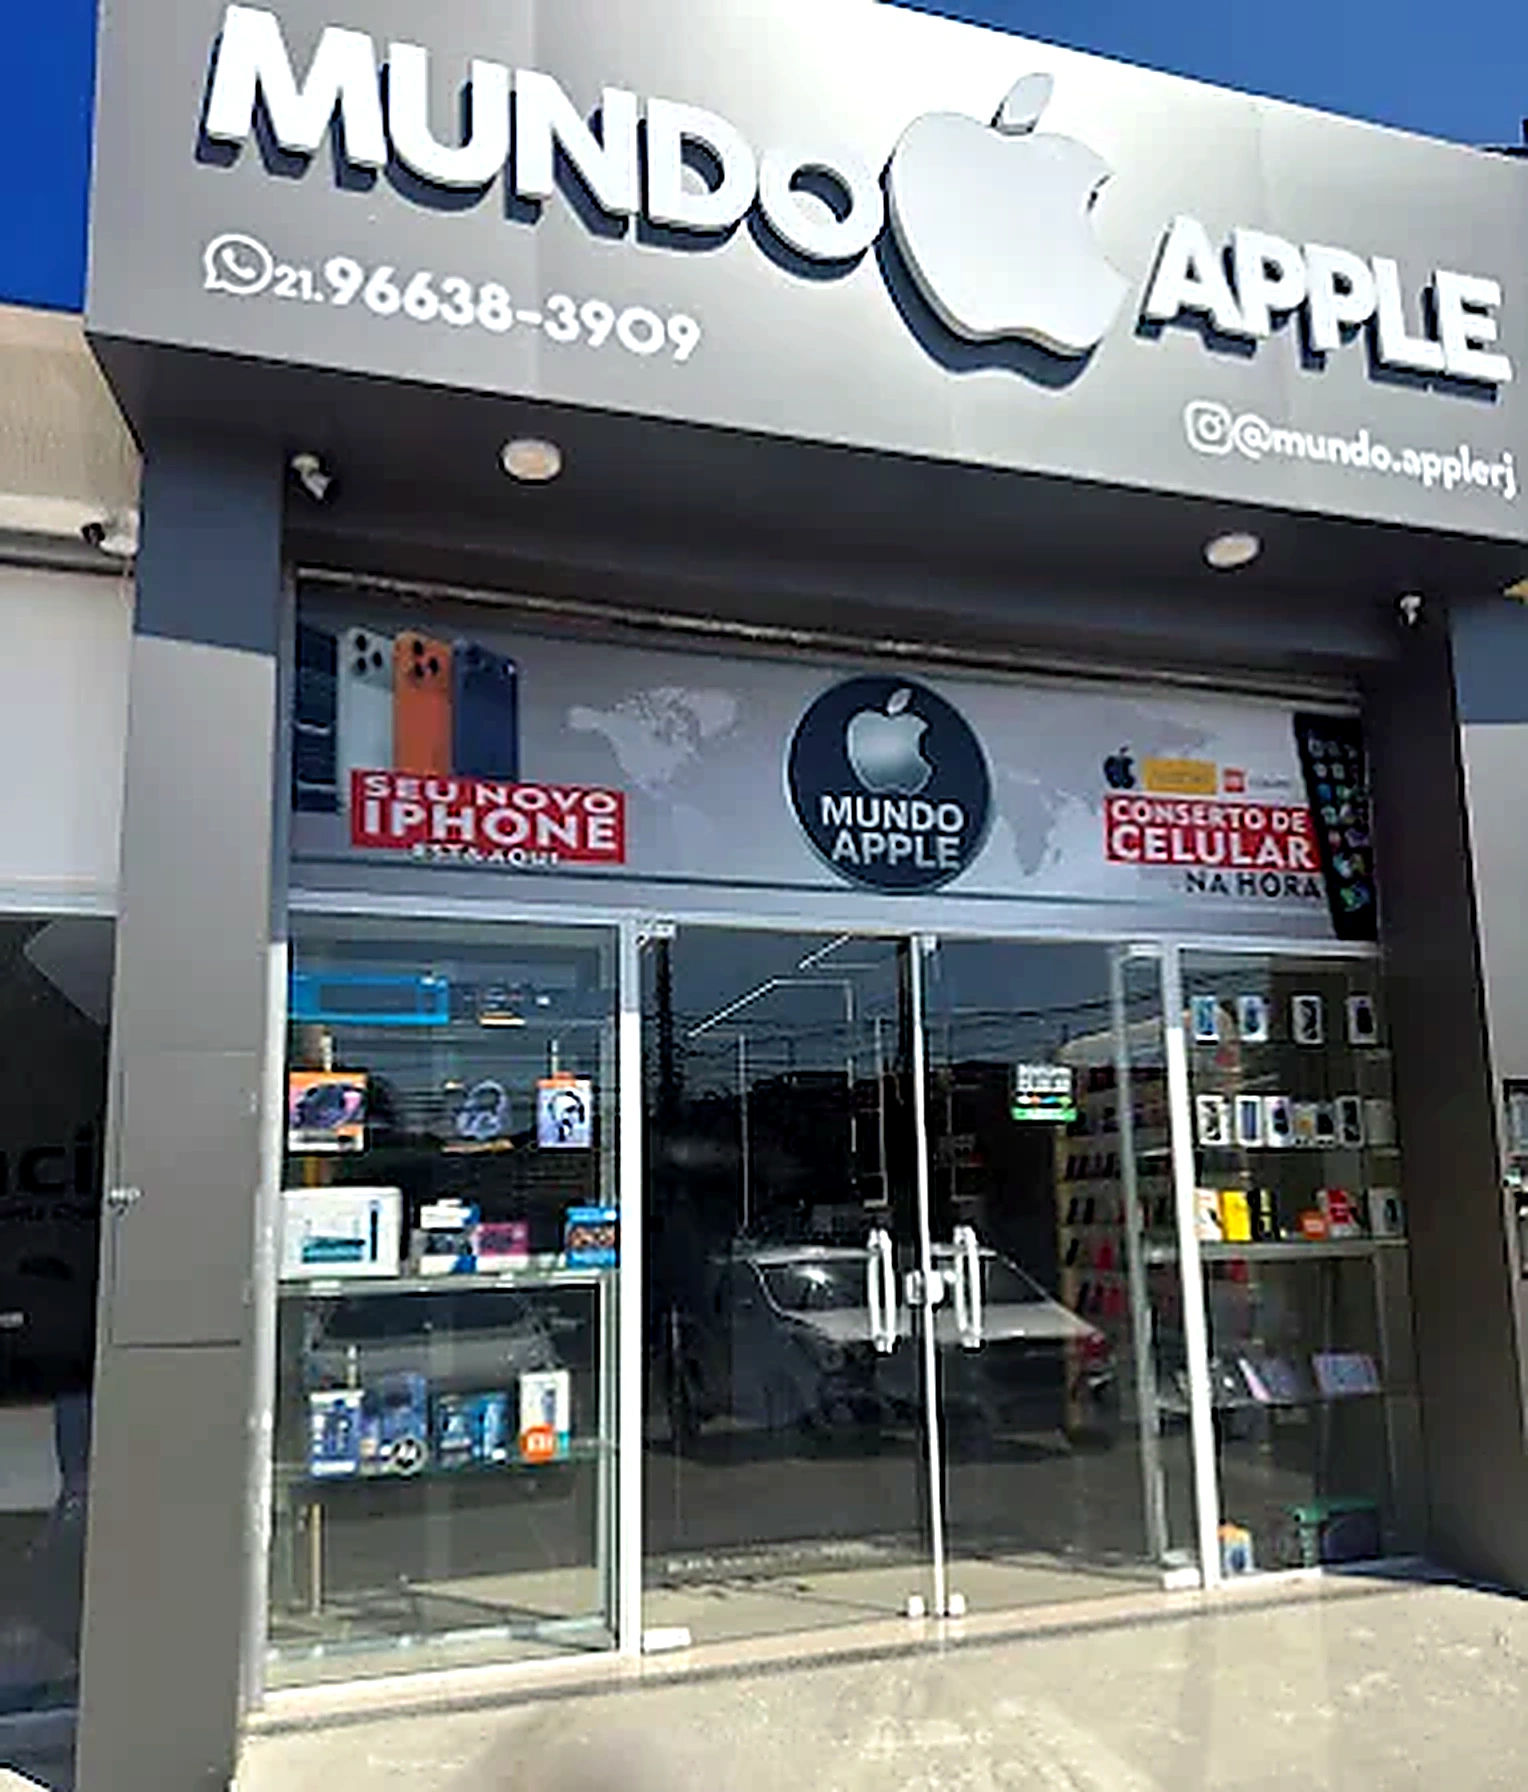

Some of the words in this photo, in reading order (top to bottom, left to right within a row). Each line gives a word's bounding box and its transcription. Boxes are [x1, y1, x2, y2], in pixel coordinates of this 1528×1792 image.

[198, 4, 884, 272] MUNDO
[1140, 214, 1513, 390] APPLE
[363, 773, 459, 803] SEU
[475, 781, 618, 814] NOVO
[820, 795, 965, 833] MUNDO
[363, 799, 618, 851] IPHONE
[1111, 799, 1267, 831] CONSERTO
[1271, 809, 1308, 833] DE
[831, 827, 962, 871] APPLE
[1110, 823, 1318, 869] CELULAR
[1184, 871, 1230, 896] NA
[1236, 872, 1322, 899] HORA
